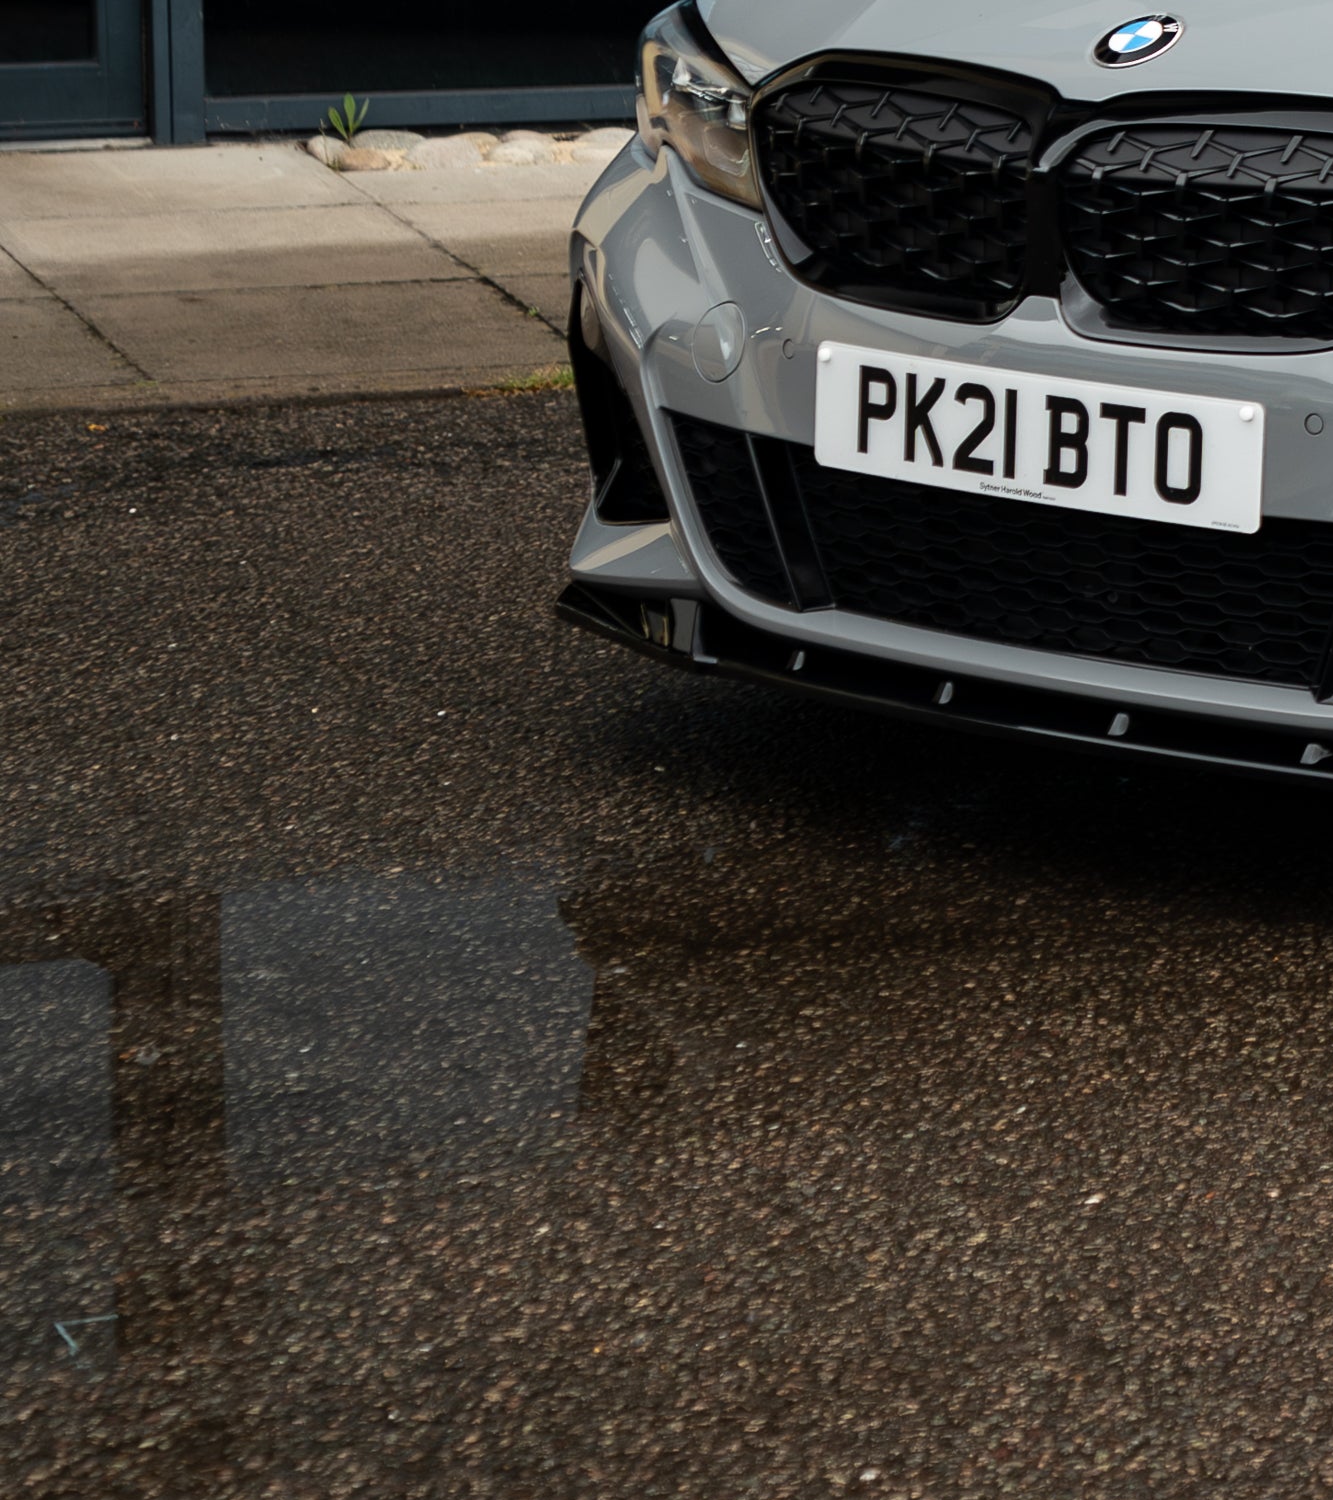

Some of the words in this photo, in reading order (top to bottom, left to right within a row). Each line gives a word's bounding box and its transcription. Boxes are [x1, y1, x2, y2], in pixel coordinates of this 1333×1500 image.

[857, 364, 1019, 481] PK21
[1043, 393, 1204, 506] BTO
[979, 481, 1001, 493] Sytner
[1001, 485, 1023, 497] Harold
[1023, 489, 1042, 499] Wood
